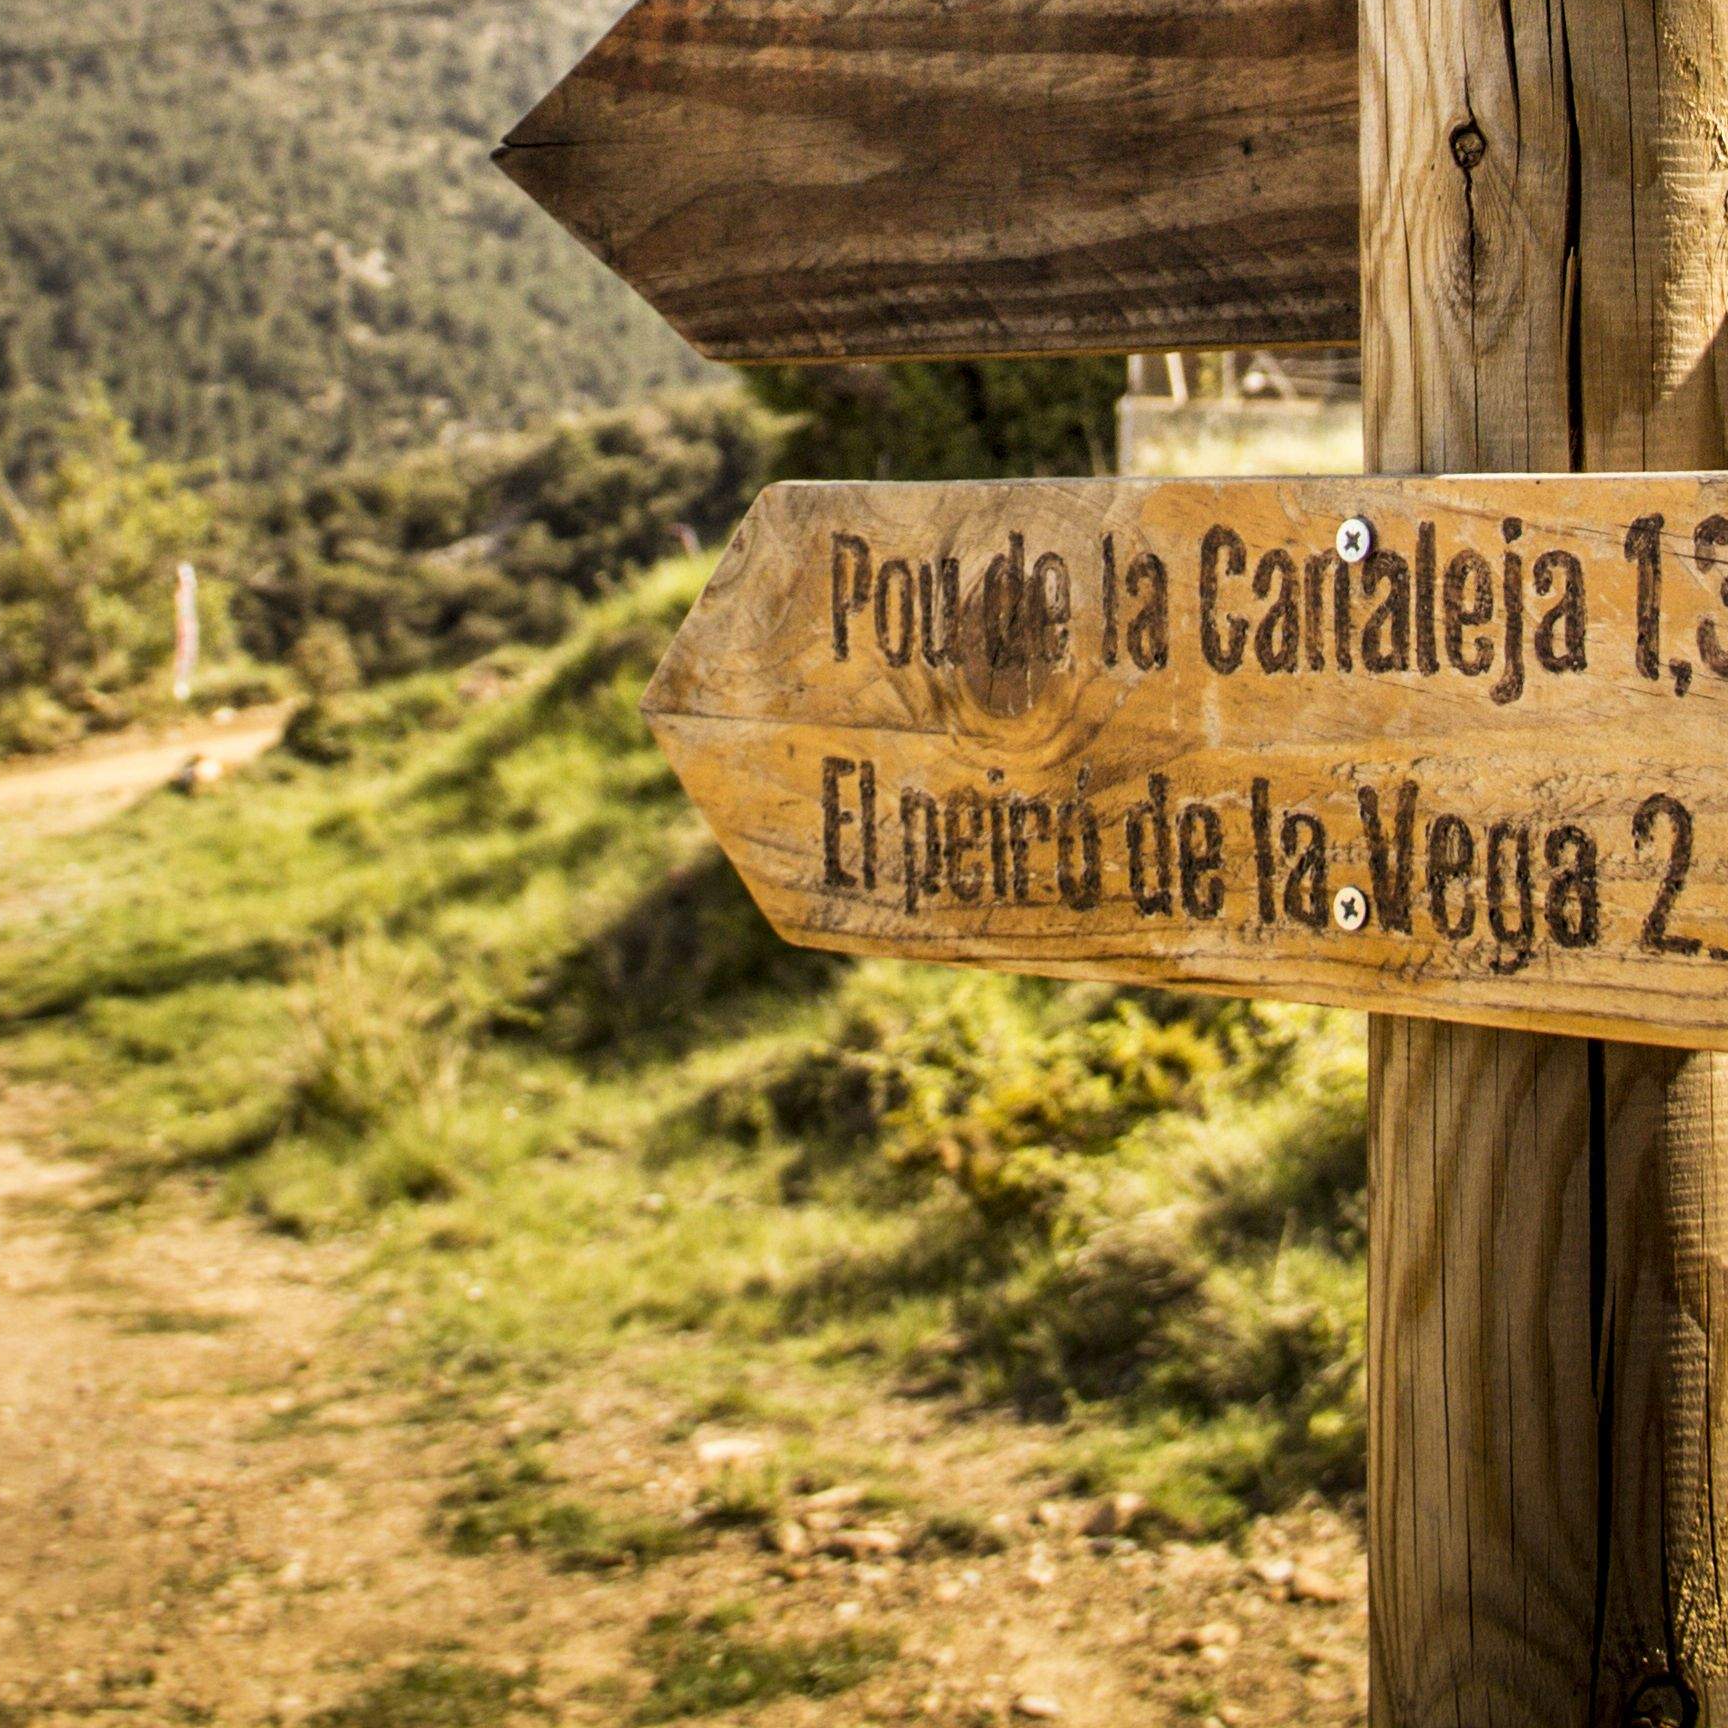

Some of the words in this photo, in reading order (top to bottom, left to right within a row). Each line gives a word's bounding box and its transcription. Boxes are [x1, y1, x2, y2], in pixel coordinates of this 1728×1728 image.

[831, 530, 961, 669] Pou
[983, 530, 1072, 672] de
[1100, 530, 1169, 673] la
[821, 755, 877, 891] El
[1125, 772, 1223, 921] de
[1250, 776, 1329, 928] la
[1357, 779, 1600, 975] Vega
